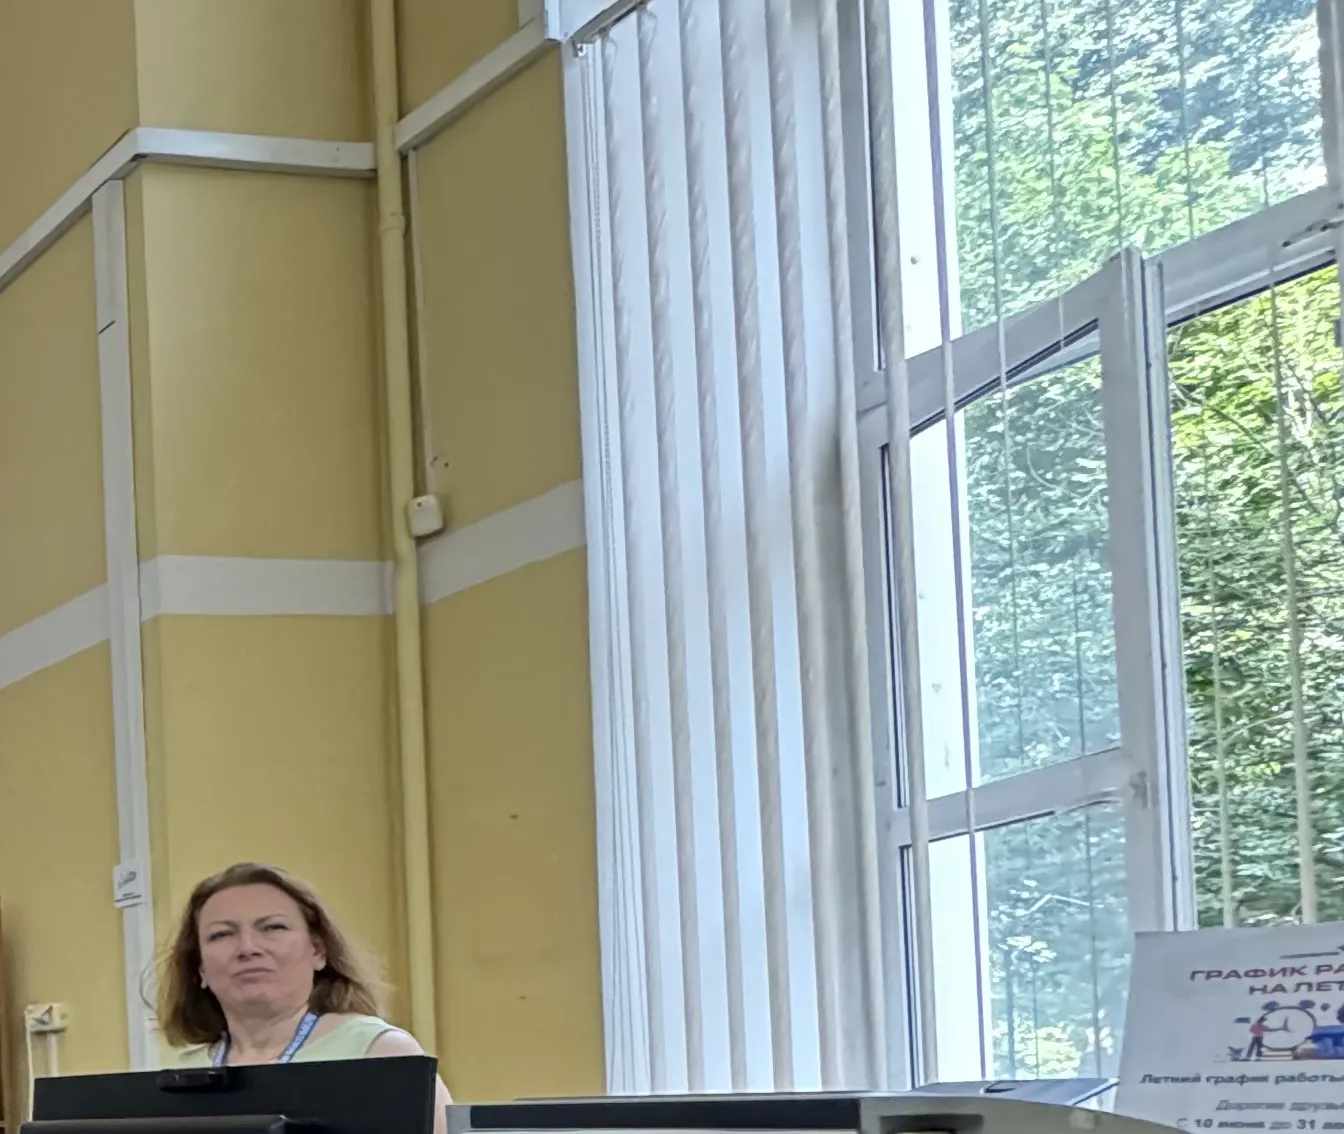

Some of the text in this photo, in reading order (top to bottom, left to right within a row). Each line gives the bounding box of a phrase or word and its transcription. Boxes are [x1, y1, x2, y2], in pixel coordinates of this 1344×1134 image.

[1189, 965, 1308, 981] ГРАФИК
[1249, 983, 1288, 995] НА
[1296, 1119, 1316, 1130] 31
